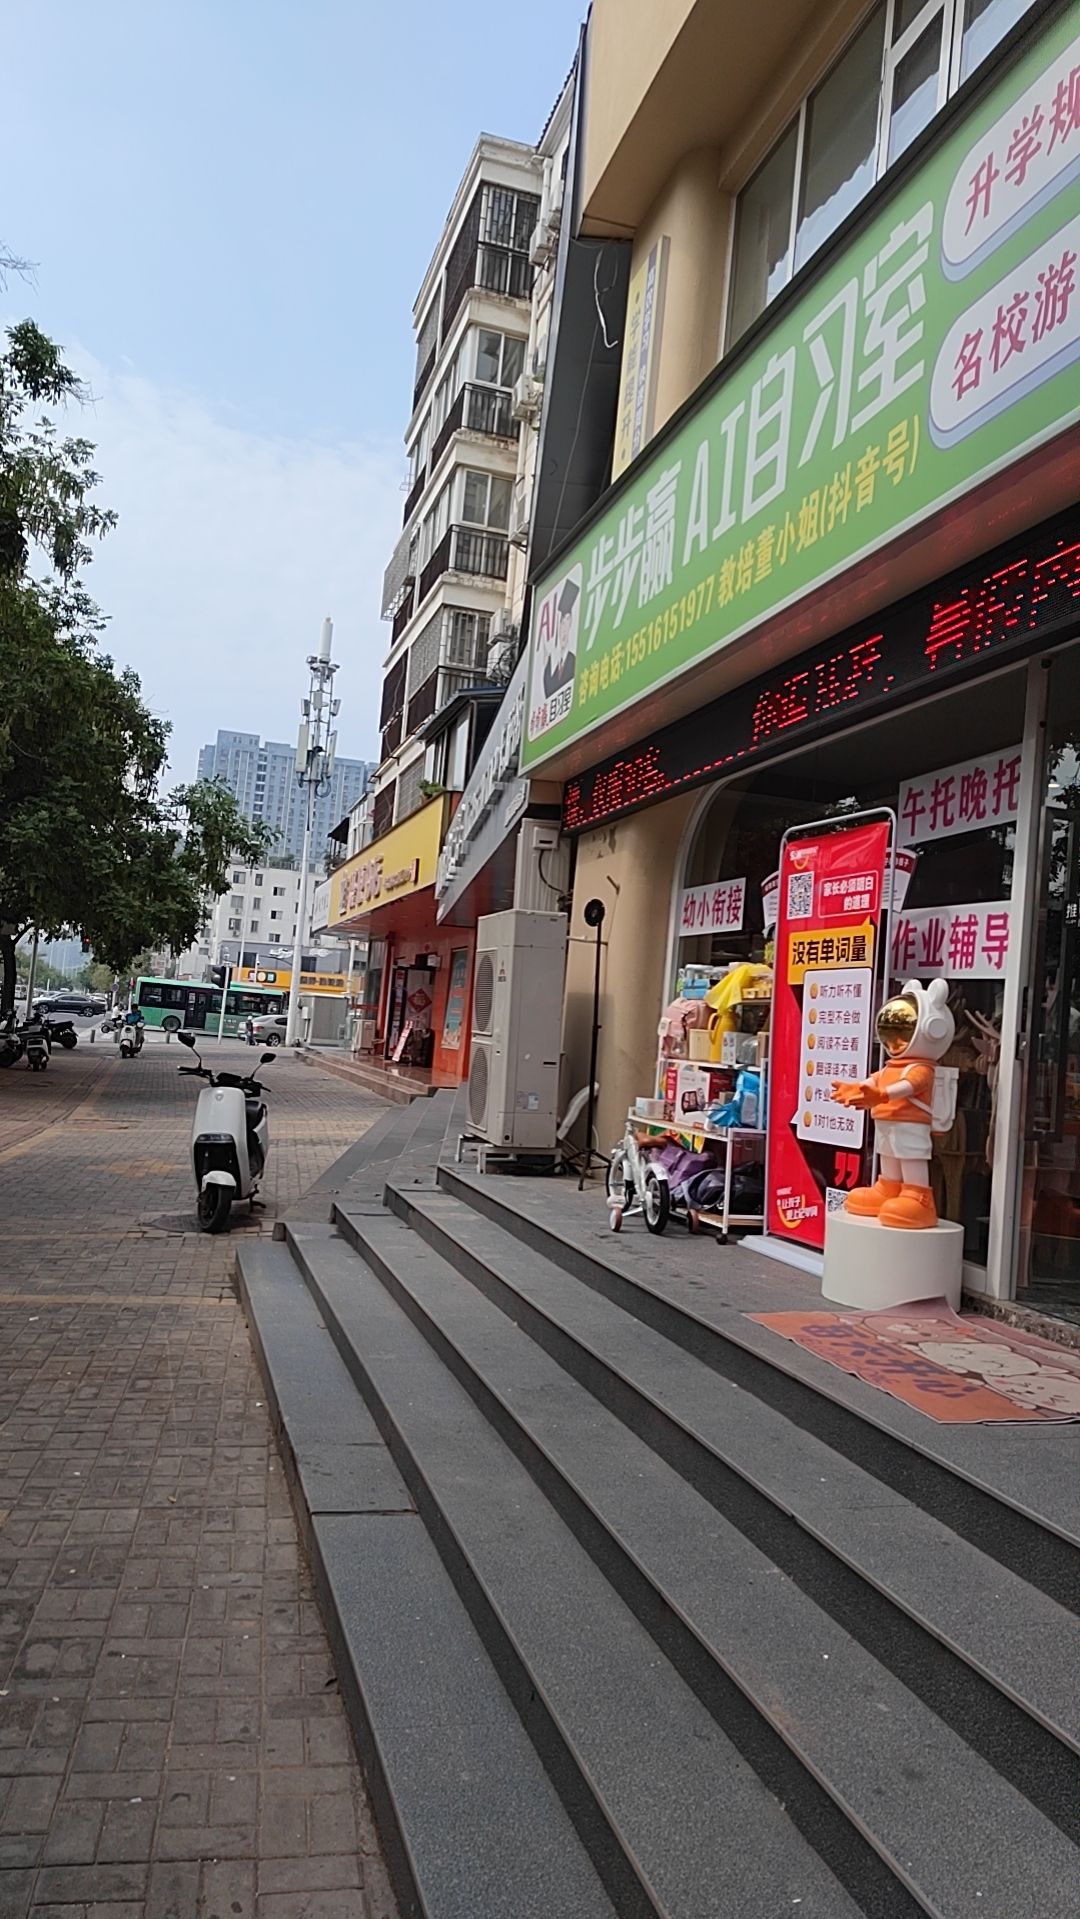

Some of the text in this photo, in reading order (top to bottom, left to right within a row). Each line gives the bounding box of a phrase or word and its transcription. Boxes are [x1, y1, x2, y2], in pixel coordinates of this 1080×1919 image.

[950, 249, 1078, 402] 名校游
[902, 755, 1021, 837] 午托晚托
[682, 887, 743, 930] 幼小衔接
[791, 935, 867, 965] 没有单词量
[891, 910, 1009, 972] 作业辅导
[819, 983, 863, 998] 听力听不懂
[818, 1011, 861, 1025] 完型不会做
[816, 1036, 859, 1052] 阅读不会看
[813, 1114, 855, 1133] 1对1也无效
